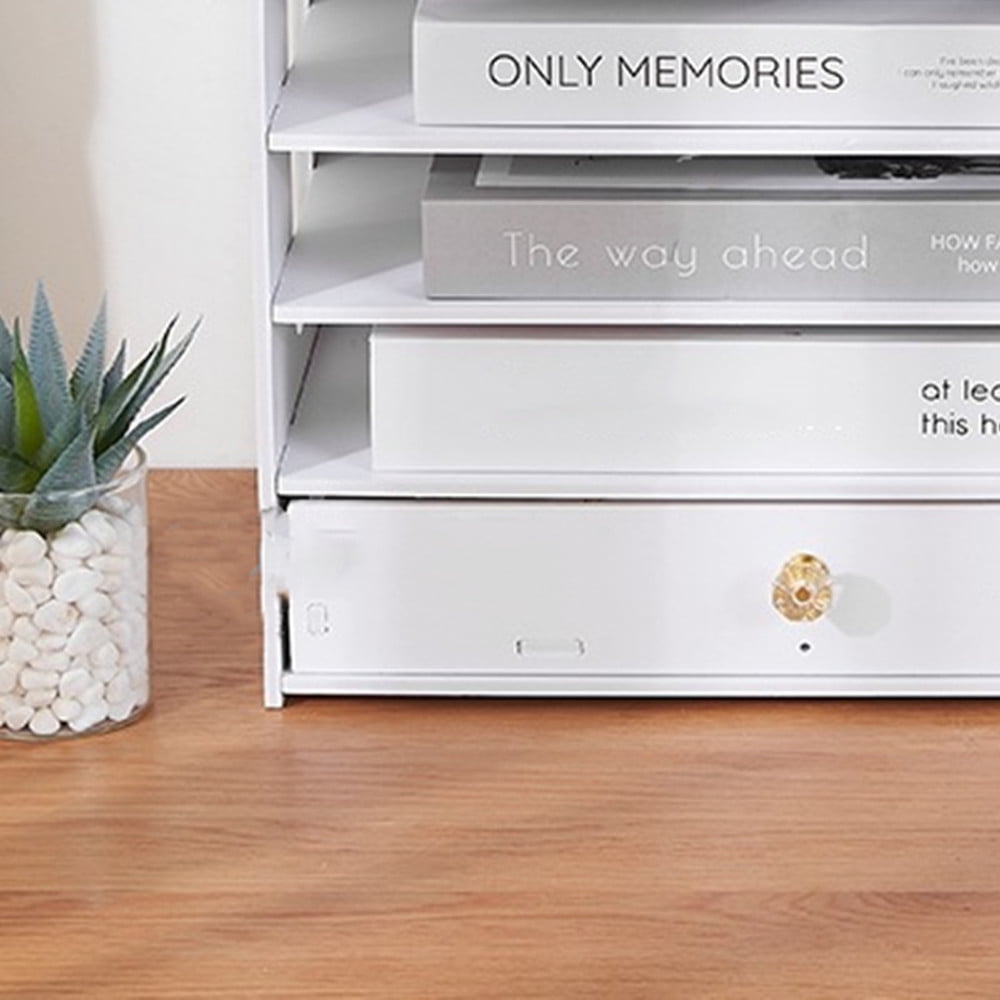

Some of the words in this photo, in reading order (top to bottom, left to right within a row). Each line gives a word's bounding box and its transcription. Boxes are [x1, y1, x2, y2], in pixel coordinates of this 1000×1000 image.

[488, 53, 603, 88] ONLY
[617, 55, 845, 91] MEMORIES
[504, 231, 579, 268] The
[605, 244, 697, 277] way
[722, 234, 867, 270] ahead
[930, 233, 981, 251] HOW
[958, 256, 999, 274] how
[921, 379, 951, 402] at
[921, 411, 969, 437] this
